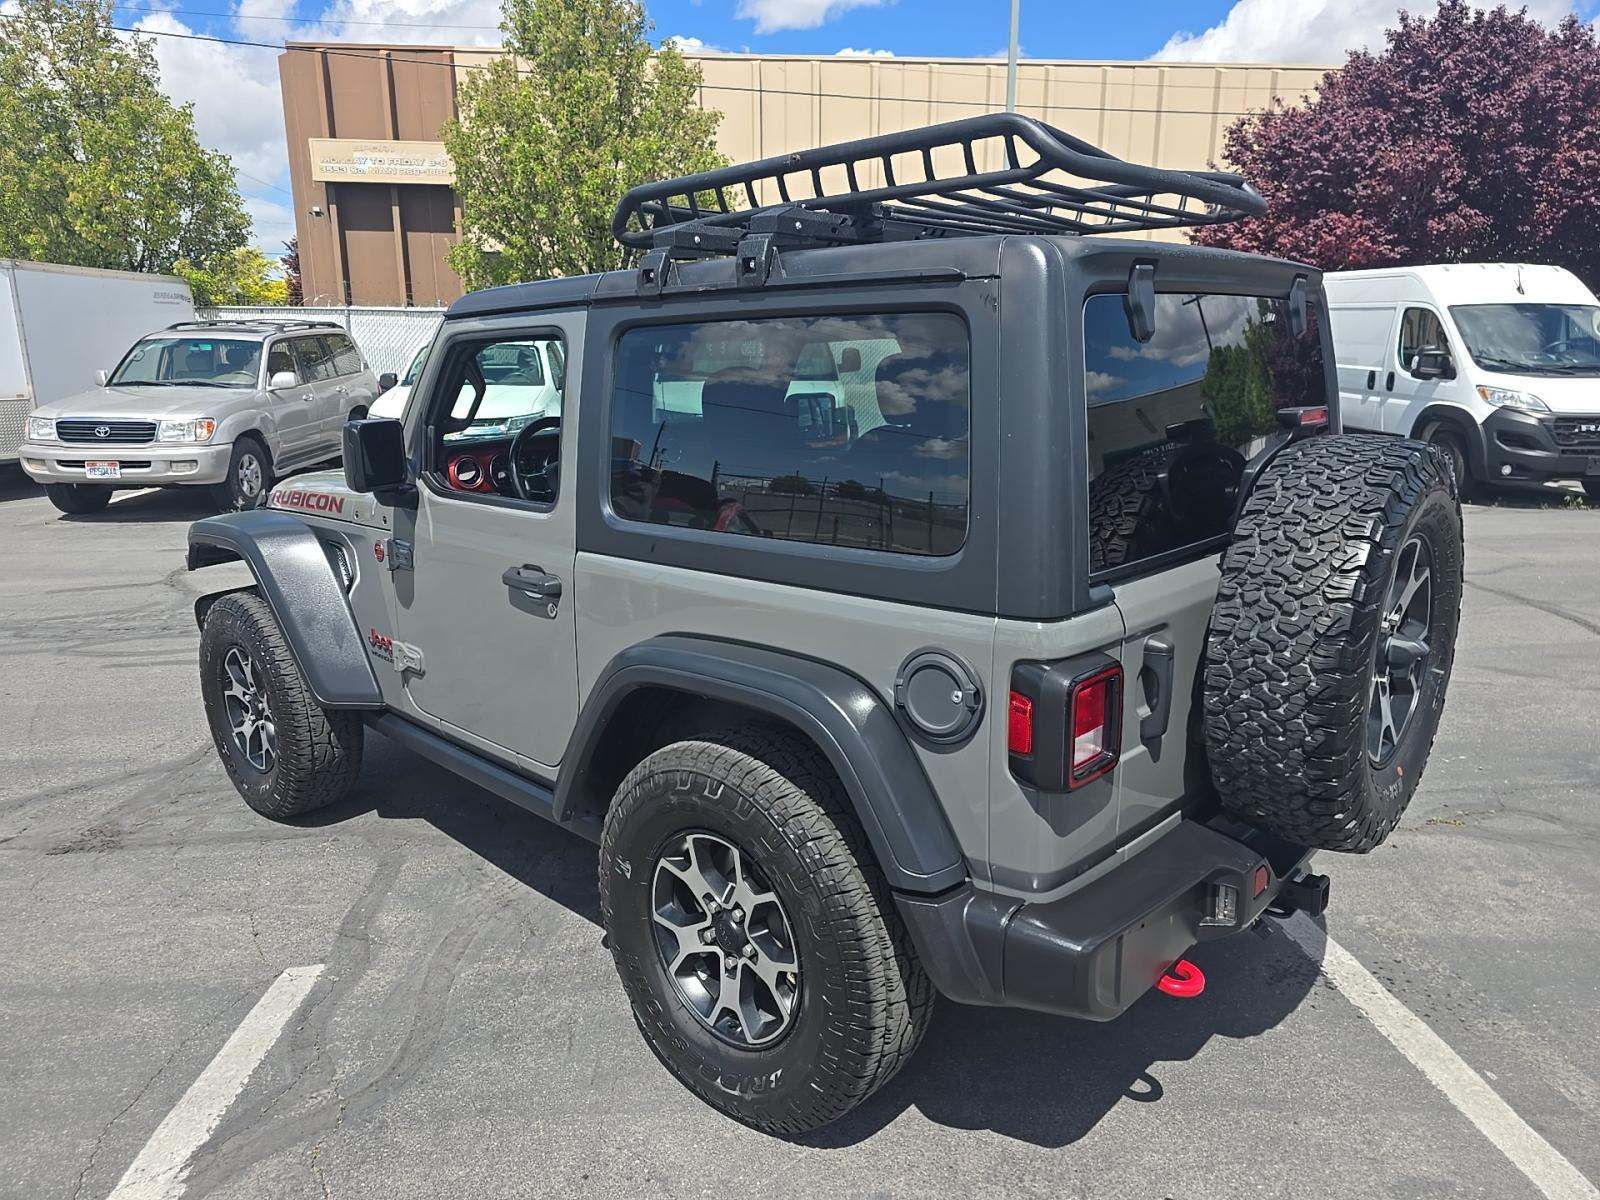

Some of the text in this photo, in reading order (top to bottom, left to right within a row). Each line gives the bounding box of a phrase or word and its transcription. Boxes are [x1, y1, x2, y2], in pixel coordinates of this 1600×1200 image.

[371, 157, 386, 166] TO
[388, 158, 425, 167] FRIDAY
[272, 489, 345, 514] RUBICON
[368, 628, 394, 658] Jeep
